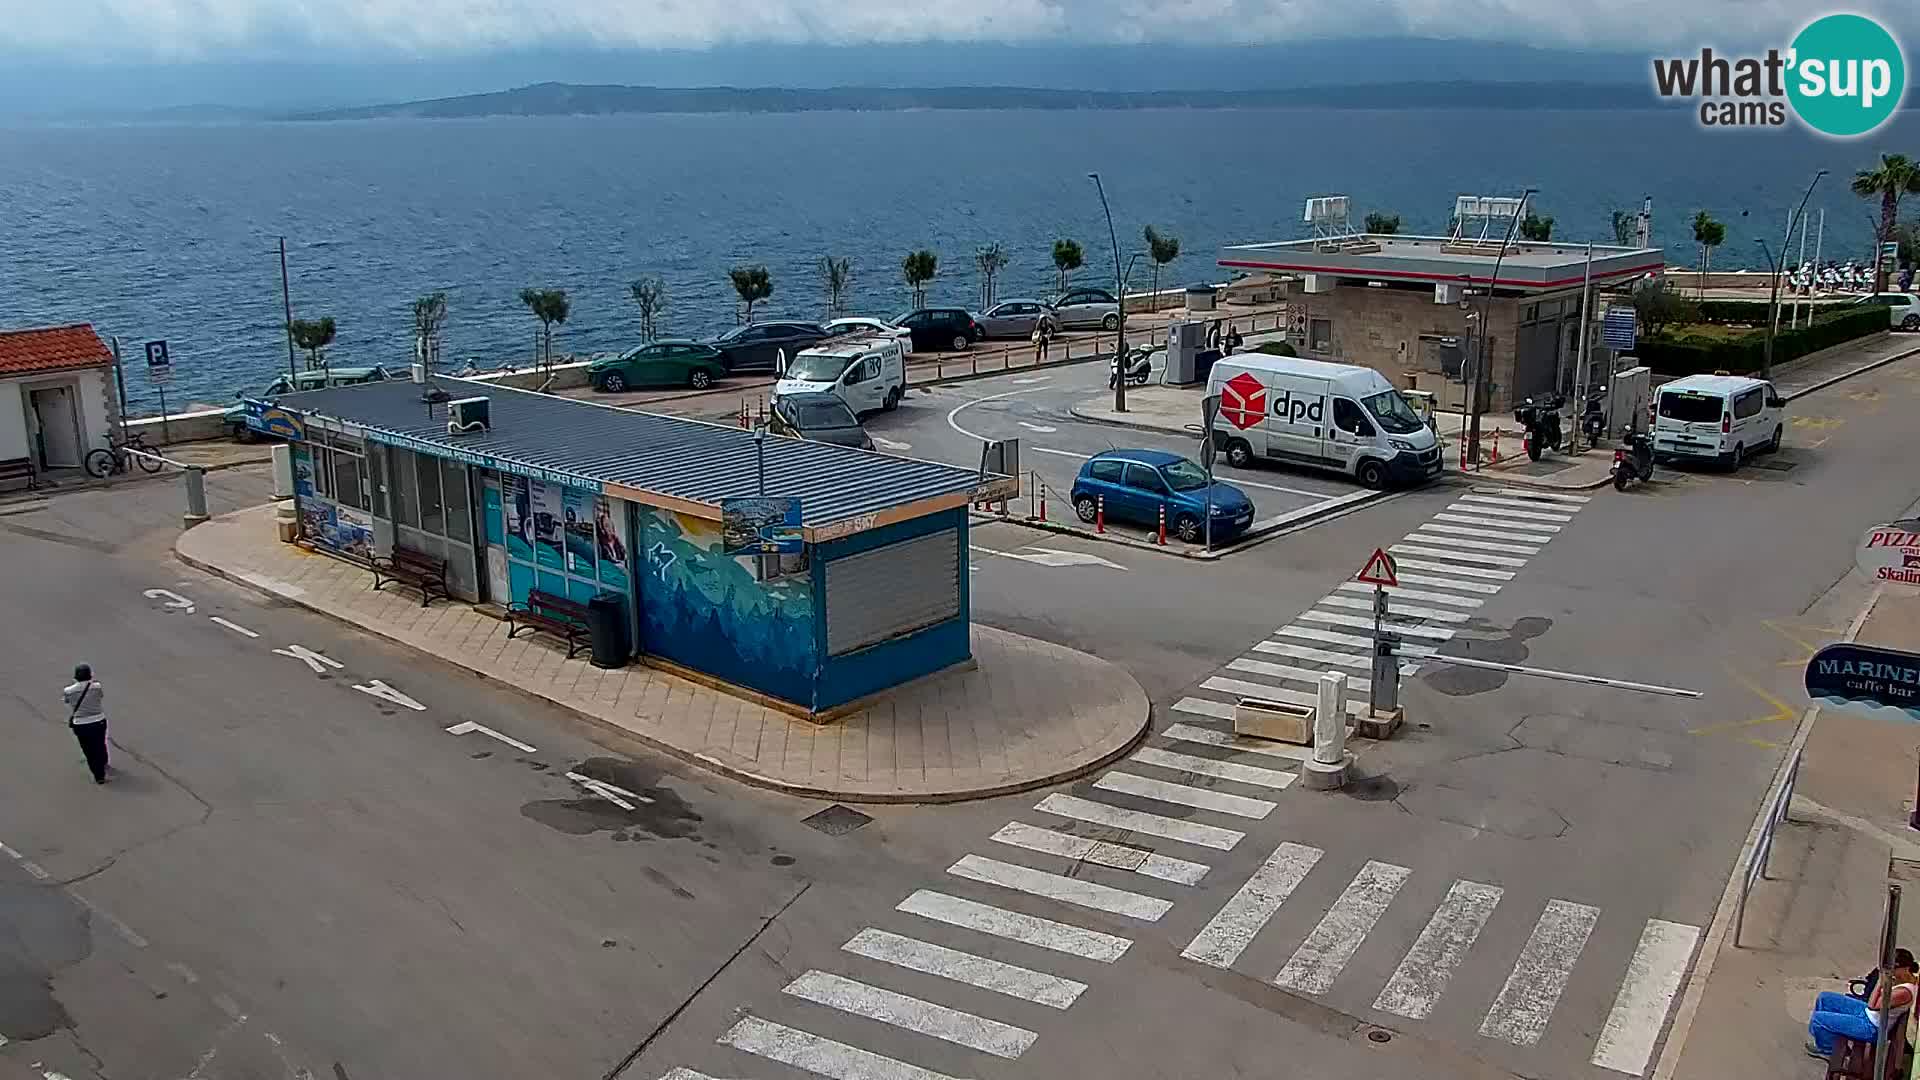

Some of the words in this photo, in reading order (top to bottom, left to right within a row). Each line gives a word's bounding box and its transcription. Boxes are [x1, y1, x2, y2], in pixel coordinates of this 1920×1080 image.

[151, 344, 163, 363] P
[1273, 391, 1325, 424] dpd
[495, 461, 510, 472] BUS
[511, 464, 543, 479] STATION
[545, 471, 571, 486] TICKET
[572, 475, 599, 491] OFFICE
[1817, 659, 1920, 686] MARINE
[1888, 683, 1916, 698] bar
